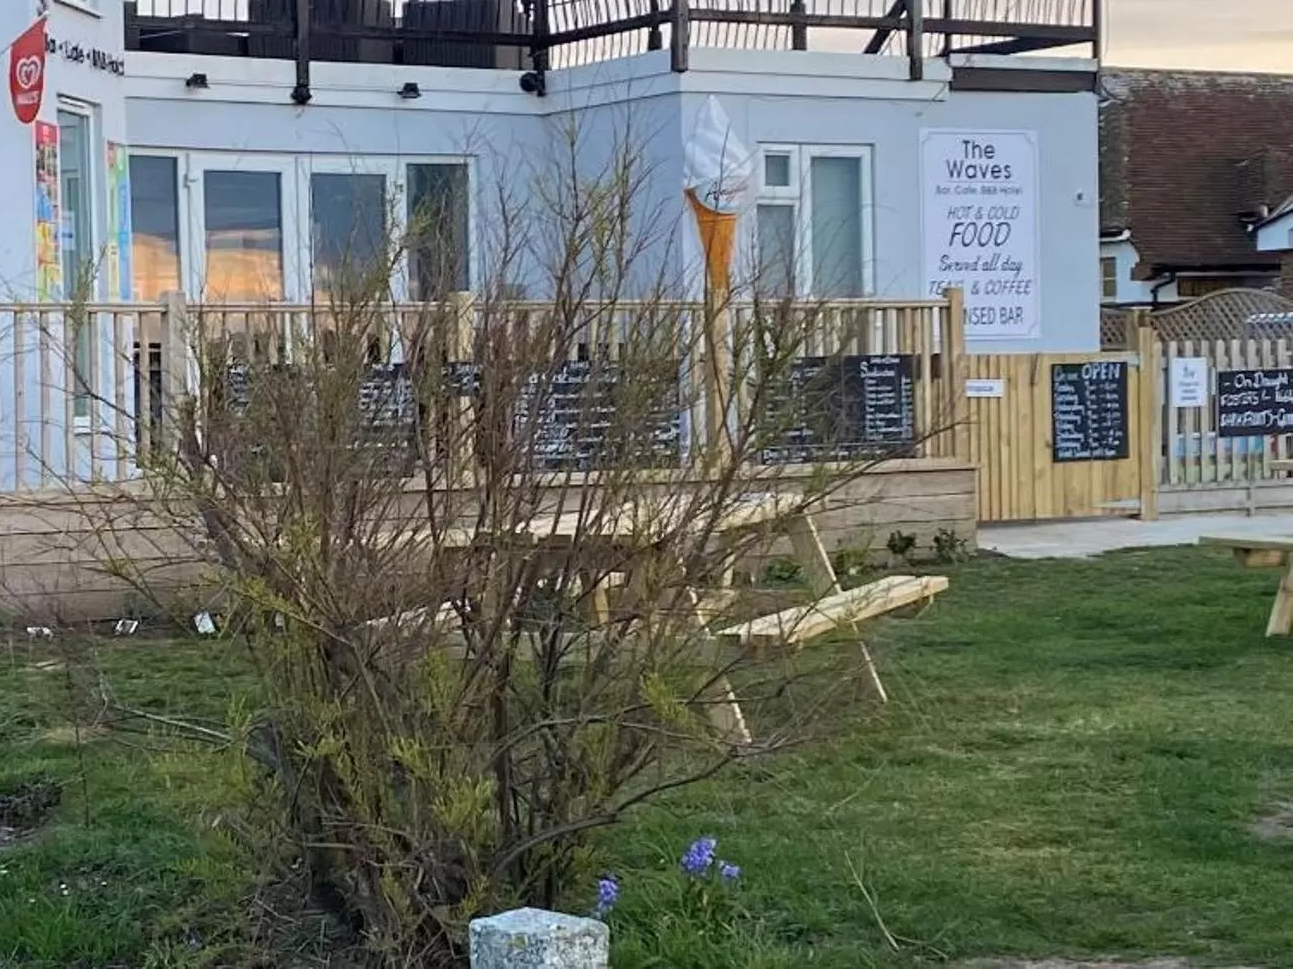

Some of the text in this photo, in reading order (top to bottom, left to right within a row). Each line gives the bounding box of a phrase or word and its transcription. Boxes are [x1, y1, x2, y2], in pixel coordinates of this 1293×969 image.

[962, 140, 995, 159] The
[946, 160, 1012, 180] Waves
[947, 205, 973, 220] HOT
[987, 205, 1020, 220] COLD
[948, 222, 1011, 247] FOOD
[982, 252, 1001, 271] all
[1002, 254, 1023, 278] day
[985, 279, 1032, 295] COFFEE
[1000, 307, 1024, 324] BAR
[1082, 363, 1120, 380] OPEN
[1234, 373, 1253, 389] On
